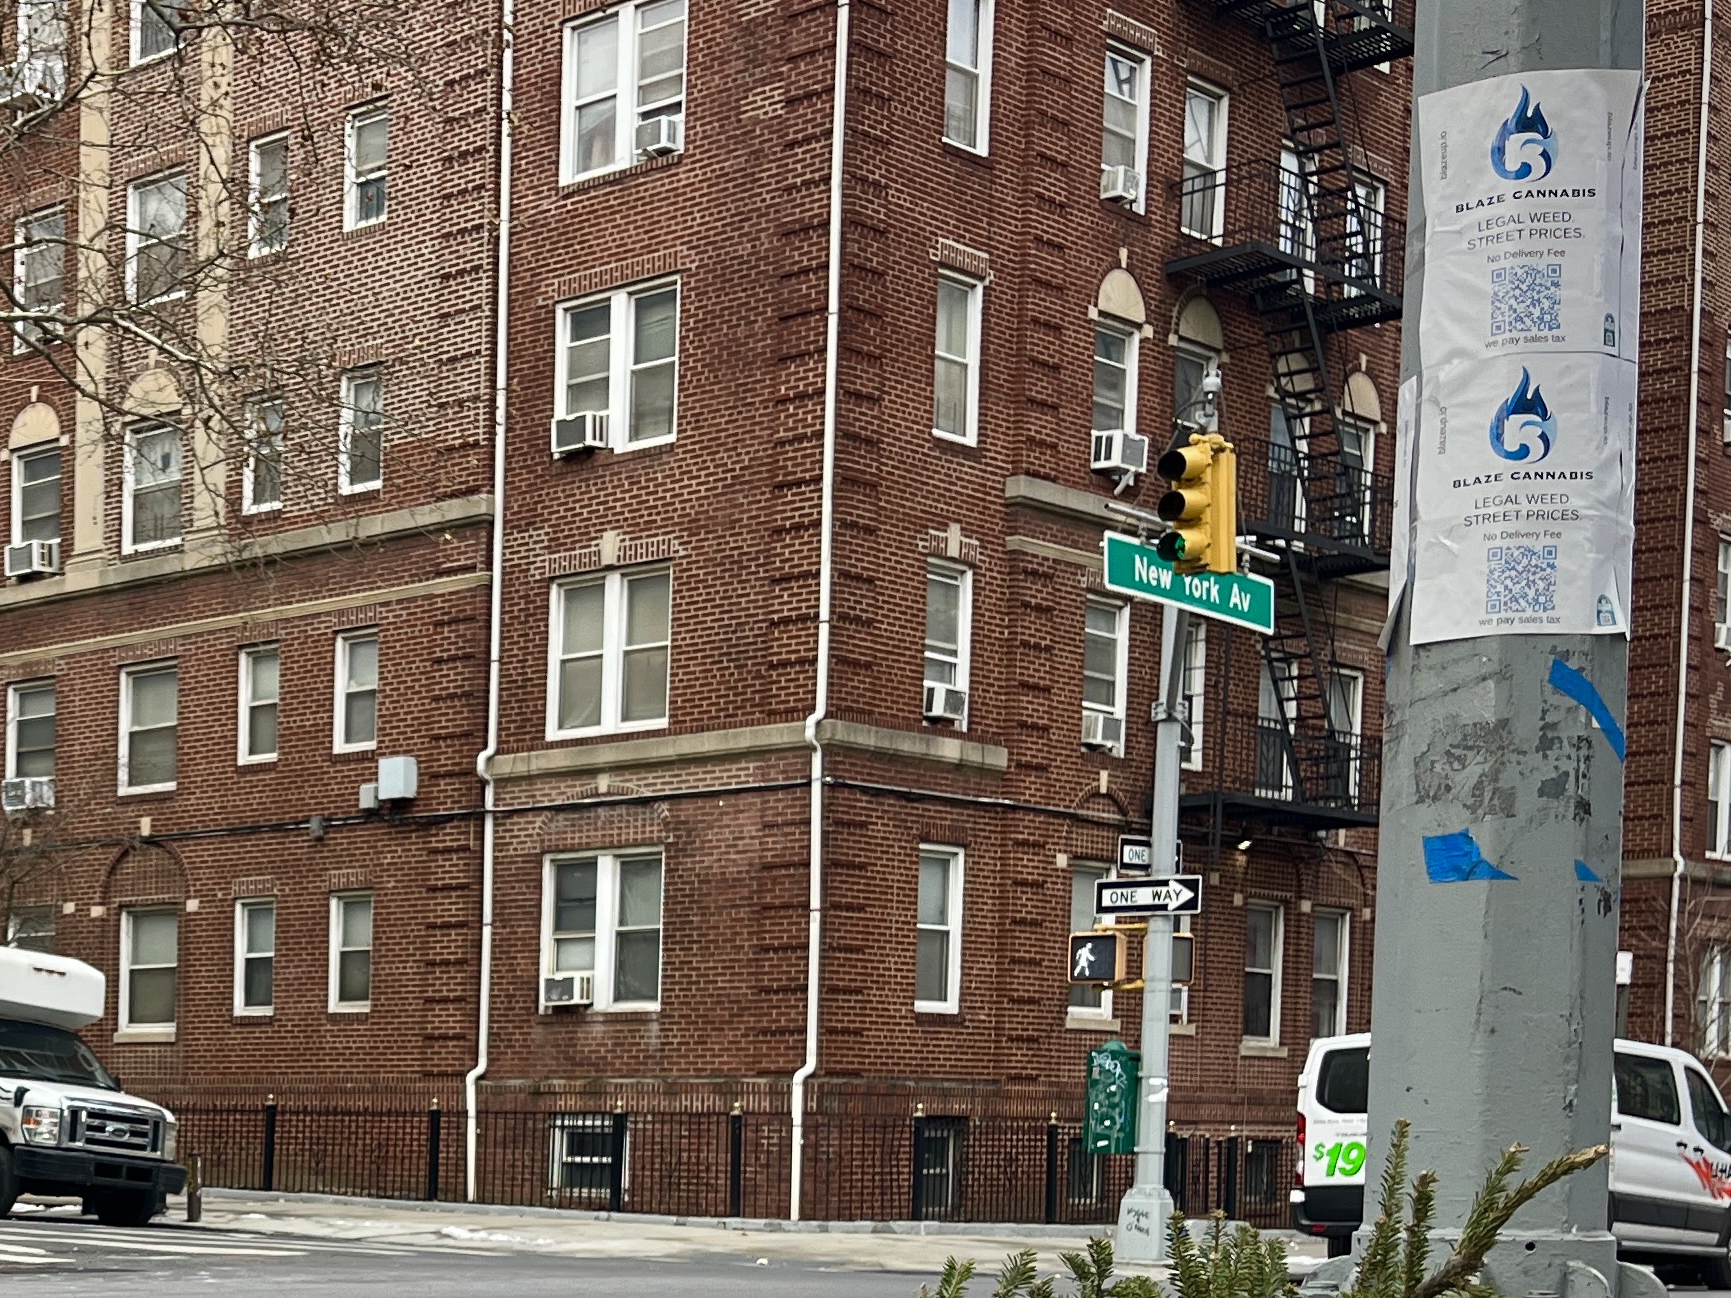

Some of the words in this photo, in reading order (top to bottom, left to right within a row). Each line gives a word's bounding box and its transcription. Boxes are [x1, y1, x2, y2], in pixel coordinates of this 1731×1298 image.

[1455, 193, 1506, 213] BLAZE
[1512, 188, 1596, 200] CANNABIS
[1478, 213, 1525, 232] LEGAL
[1467, 228, 1525, 250] STREET
[1487, 254, 1501, 264] No
[1504, 248, 1544, 259] Delivery
[1547, 248, 1566, 257] Fee
[1485, 340, 1498, 349] we
[1501, 336, 1520, 347] pay
[1523, 334, 1549, 343] sales
[1453, 473, 1504, 488] BLAZE
[1511, 471, 1594, 480] CANNABIS
[1474, 494, 1522, 509] LEGAL
[1463, 510, 1522, 527] STREET
[1483, 533, 1497, 541] No
[1500, 530, 1541, 540] Delivery
[1543, 530, 1562, 539] Fee
[1135, 554, 1172, 590] New
[1183, 573, 1219, 604] York
[1229, 582, 1250, 612] Av
[1479, 618, 1493, 626] we
[1496, 616, 1515, 626] pay
[1518, 616, 1543, 624] sales
[1546, 616, 1561, 624] tax
[1129, 849, 1146, 862] ONE
[1110, 891, 1137, 904] ONE
[1152, 889, 1183, 902] WAY
